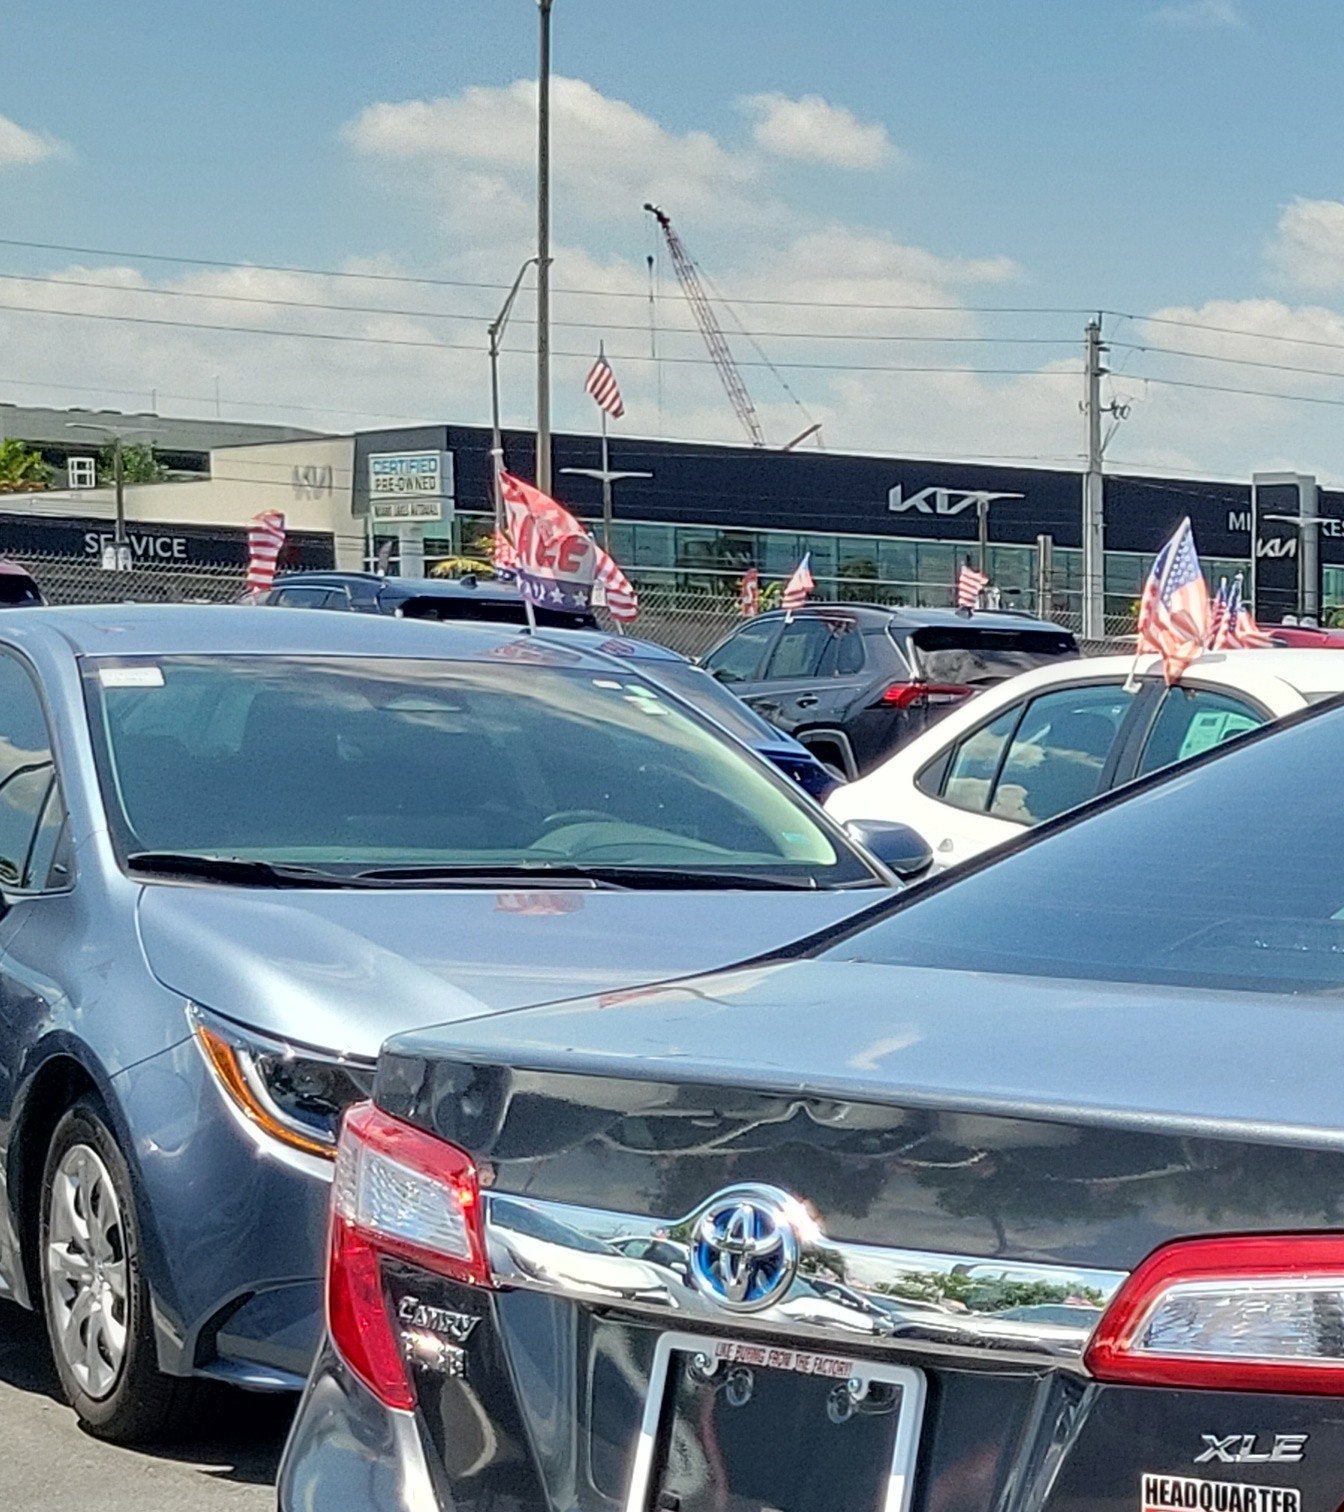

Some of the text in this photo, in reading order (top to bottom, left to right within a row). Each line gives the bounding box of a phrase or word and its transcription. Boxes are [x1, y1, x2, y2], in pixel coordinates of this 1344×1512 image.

[373, 458, 436, 475] CERTIFIED
[375, 476, 436, 492] PRE-OWNED
[85, 532, 187, 558] SEVICE
[1256, 538, 1298, 558] KIA
[1194, 1434, 1308, 1463] XLE
